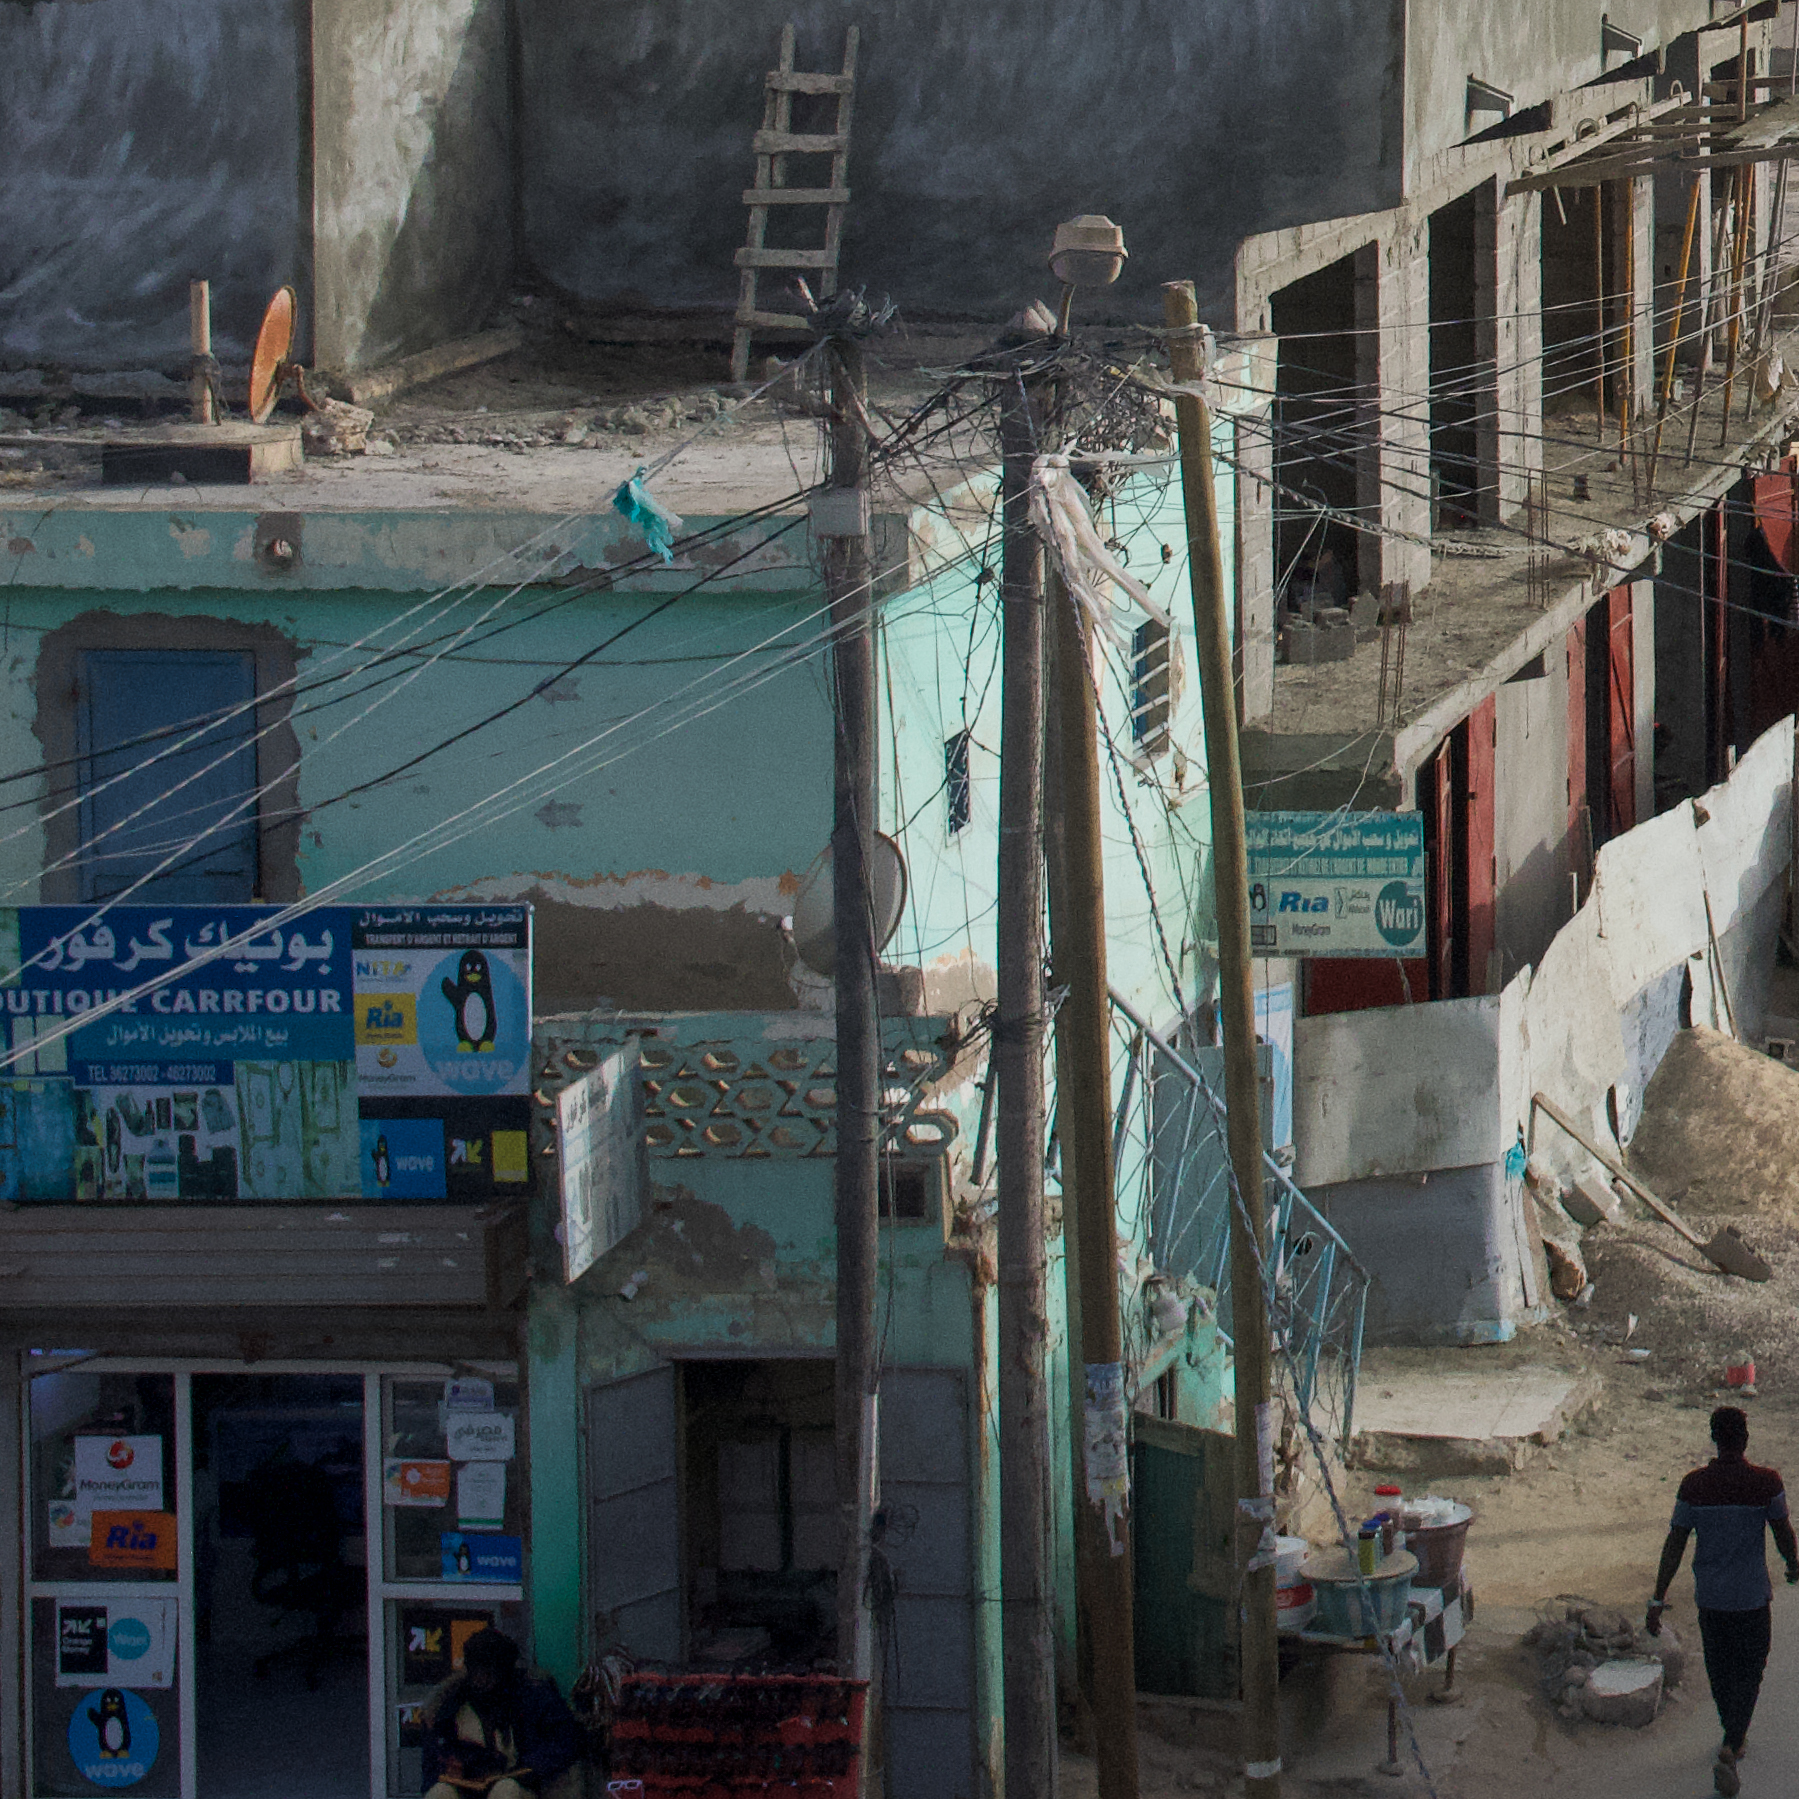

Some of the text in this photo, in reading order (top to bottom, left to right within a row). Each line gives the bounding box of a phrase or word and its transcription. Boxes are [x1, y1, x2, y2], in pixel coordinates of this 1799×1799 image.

[1278, 891, 1330, 913] Ria
[1379, 899, 1419, 929] Wari
[36, 915, 335, 976] بوتيك كرفور
[0, 988, 342, 1014] UTIQUE CARRFOUR
[366, 999, 403, 1029] Ria
[88, 1064, 108, 1082] TEL
[435, 1059, 515, 1081] wave
[395, 1155, 434, 1172] wave
[80, 1479, 160, 1492] MoneyGram
[106, 1519, 157, 1549] Ria
[476, 1555, 517, 1567] wave
[85, 1762, 145, 1779] wave
